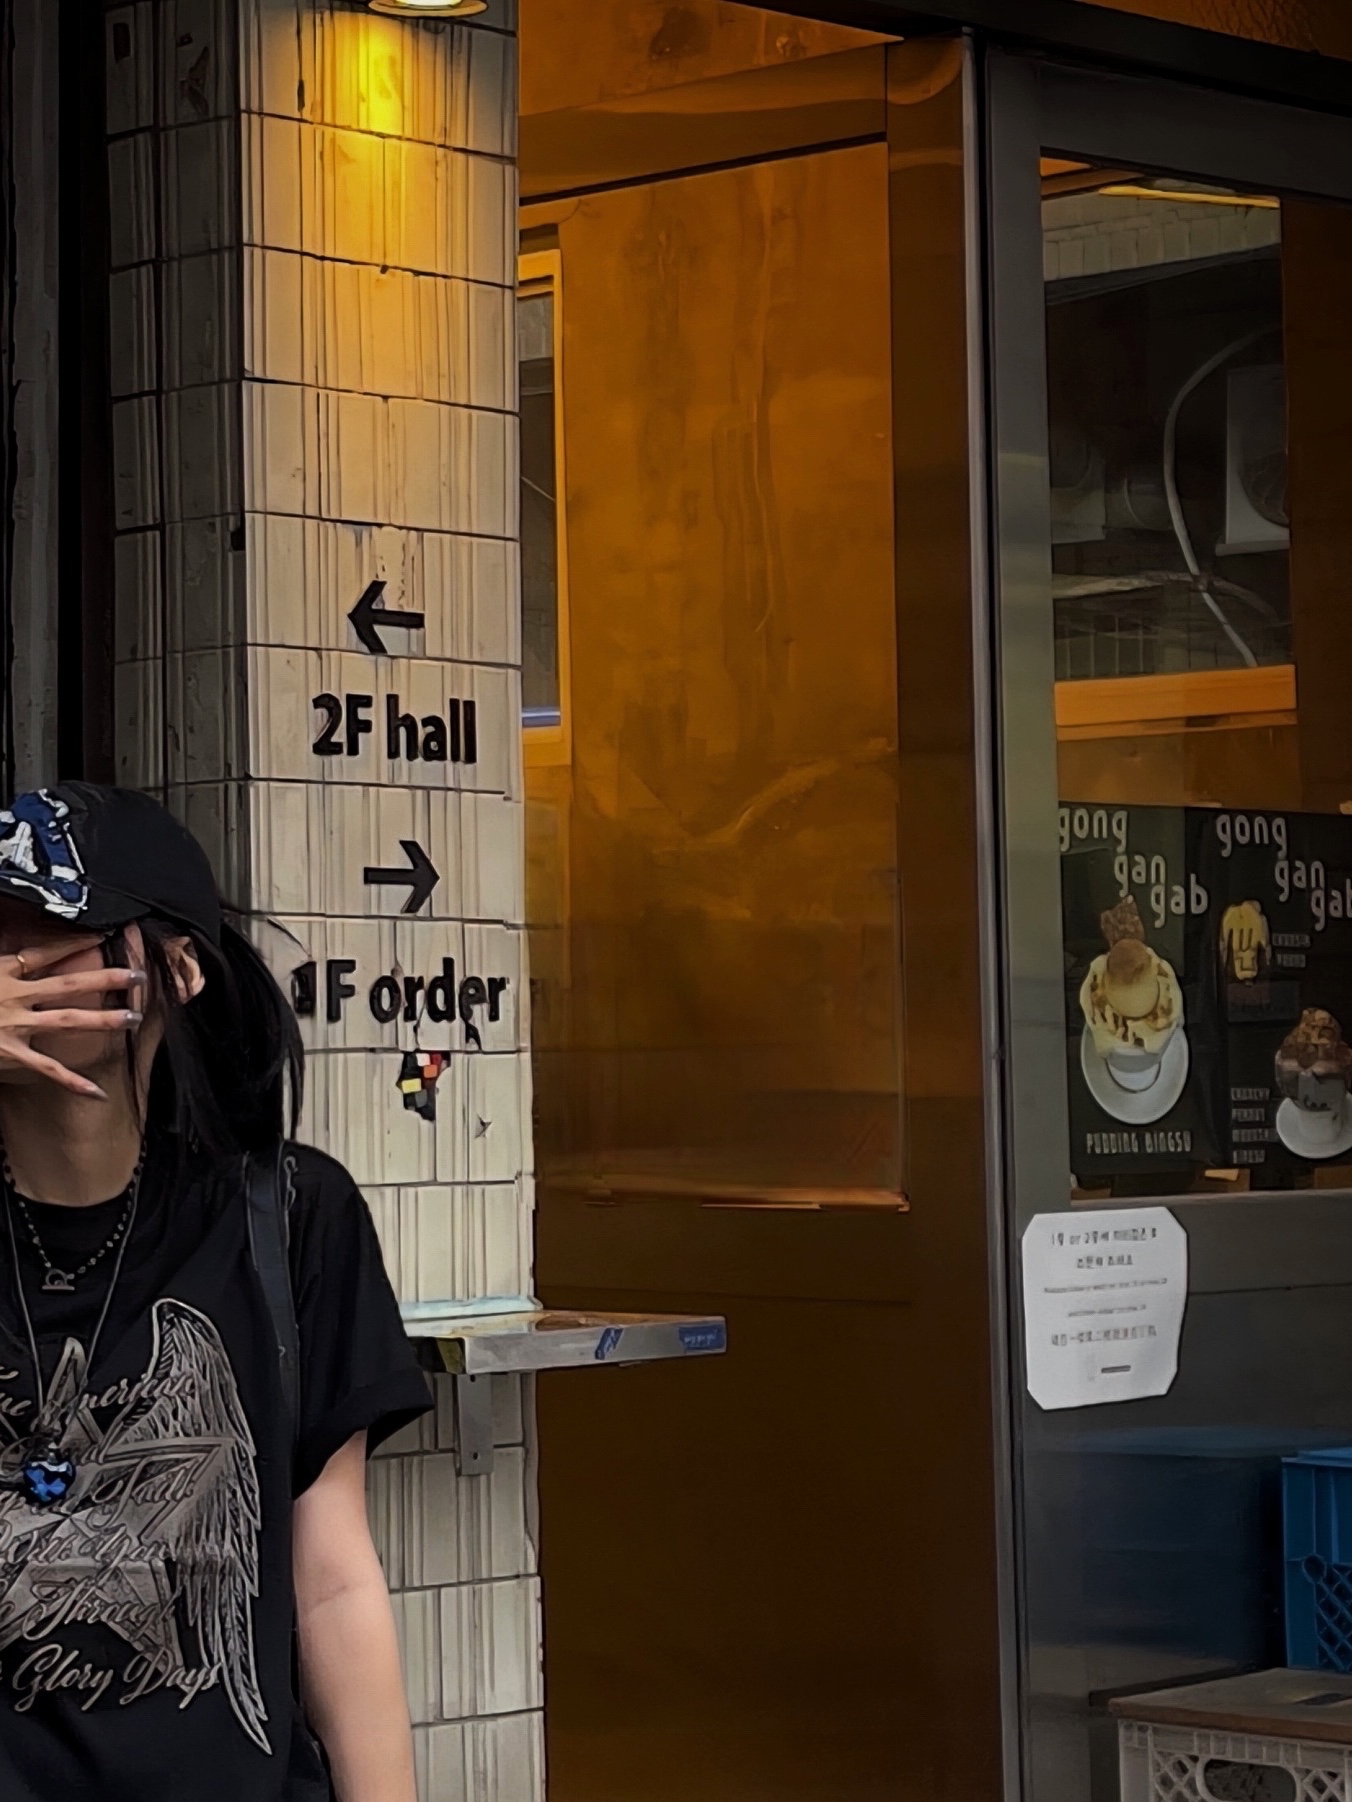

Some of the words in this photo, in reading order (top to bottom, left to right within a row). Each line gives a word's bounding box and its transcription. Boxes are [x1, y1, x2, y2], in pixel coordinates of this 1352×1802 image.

[312, 693, 373, 756] 2F
[386, 693, 477, 763] hall
[1059, 807, 1128, 854] gong
[1216, 814, 1287, 860] gong
[1114, 854, 1166, 898] gan
[1150, 873, 1209, 928] gab
[1274, 860, 1325, 902] gan
[369, 956, 510, 1024] order
[13, 1644, 114, 1712] Glory
[120, 1648, 221, 1709] Days
